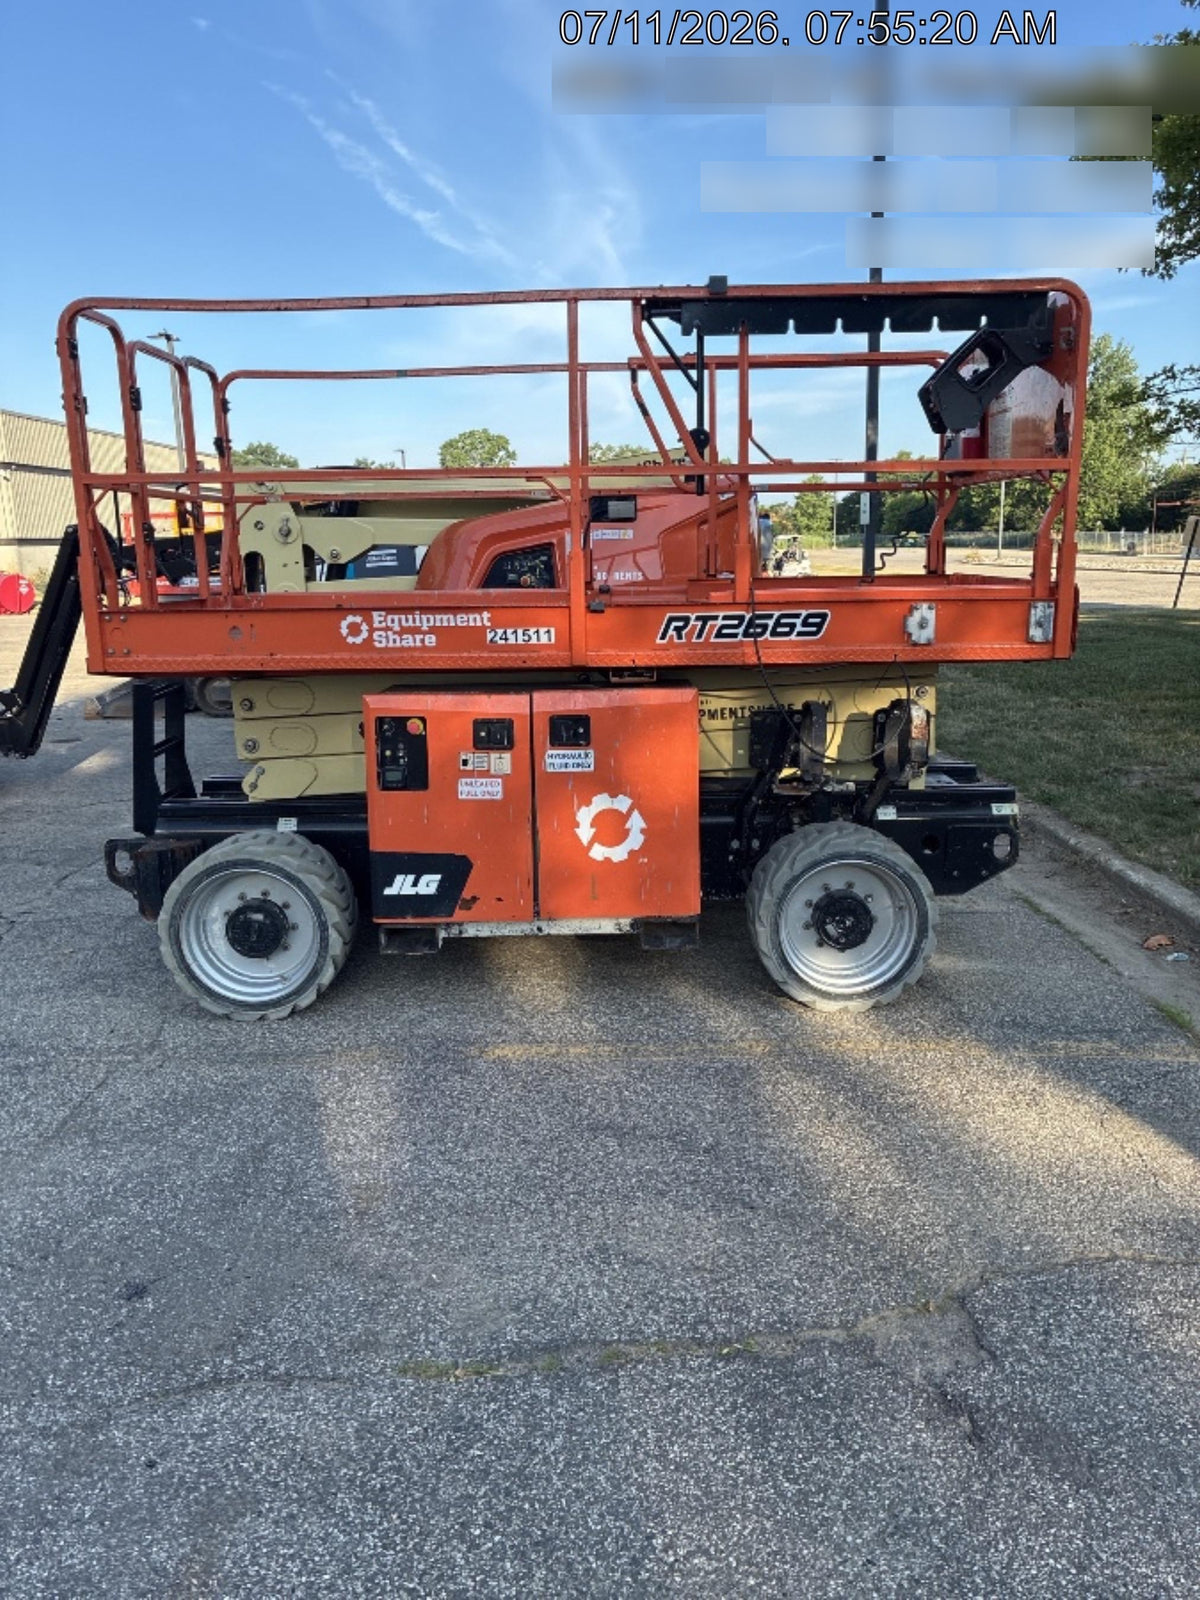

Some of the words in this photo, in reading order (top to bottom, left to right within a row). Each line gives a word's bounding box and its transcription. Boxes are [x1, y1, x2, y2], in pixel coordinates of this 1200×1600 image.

[372, 611, 491, 630] Equipment
[657, 610, 831, 643] RT2669
[372, 630, 437, 648] Share
[488, 629, 553, 644] 241511
[547, 751, 592, 760] HYDRAULIC
[383, 873, 442, 895] JLG
